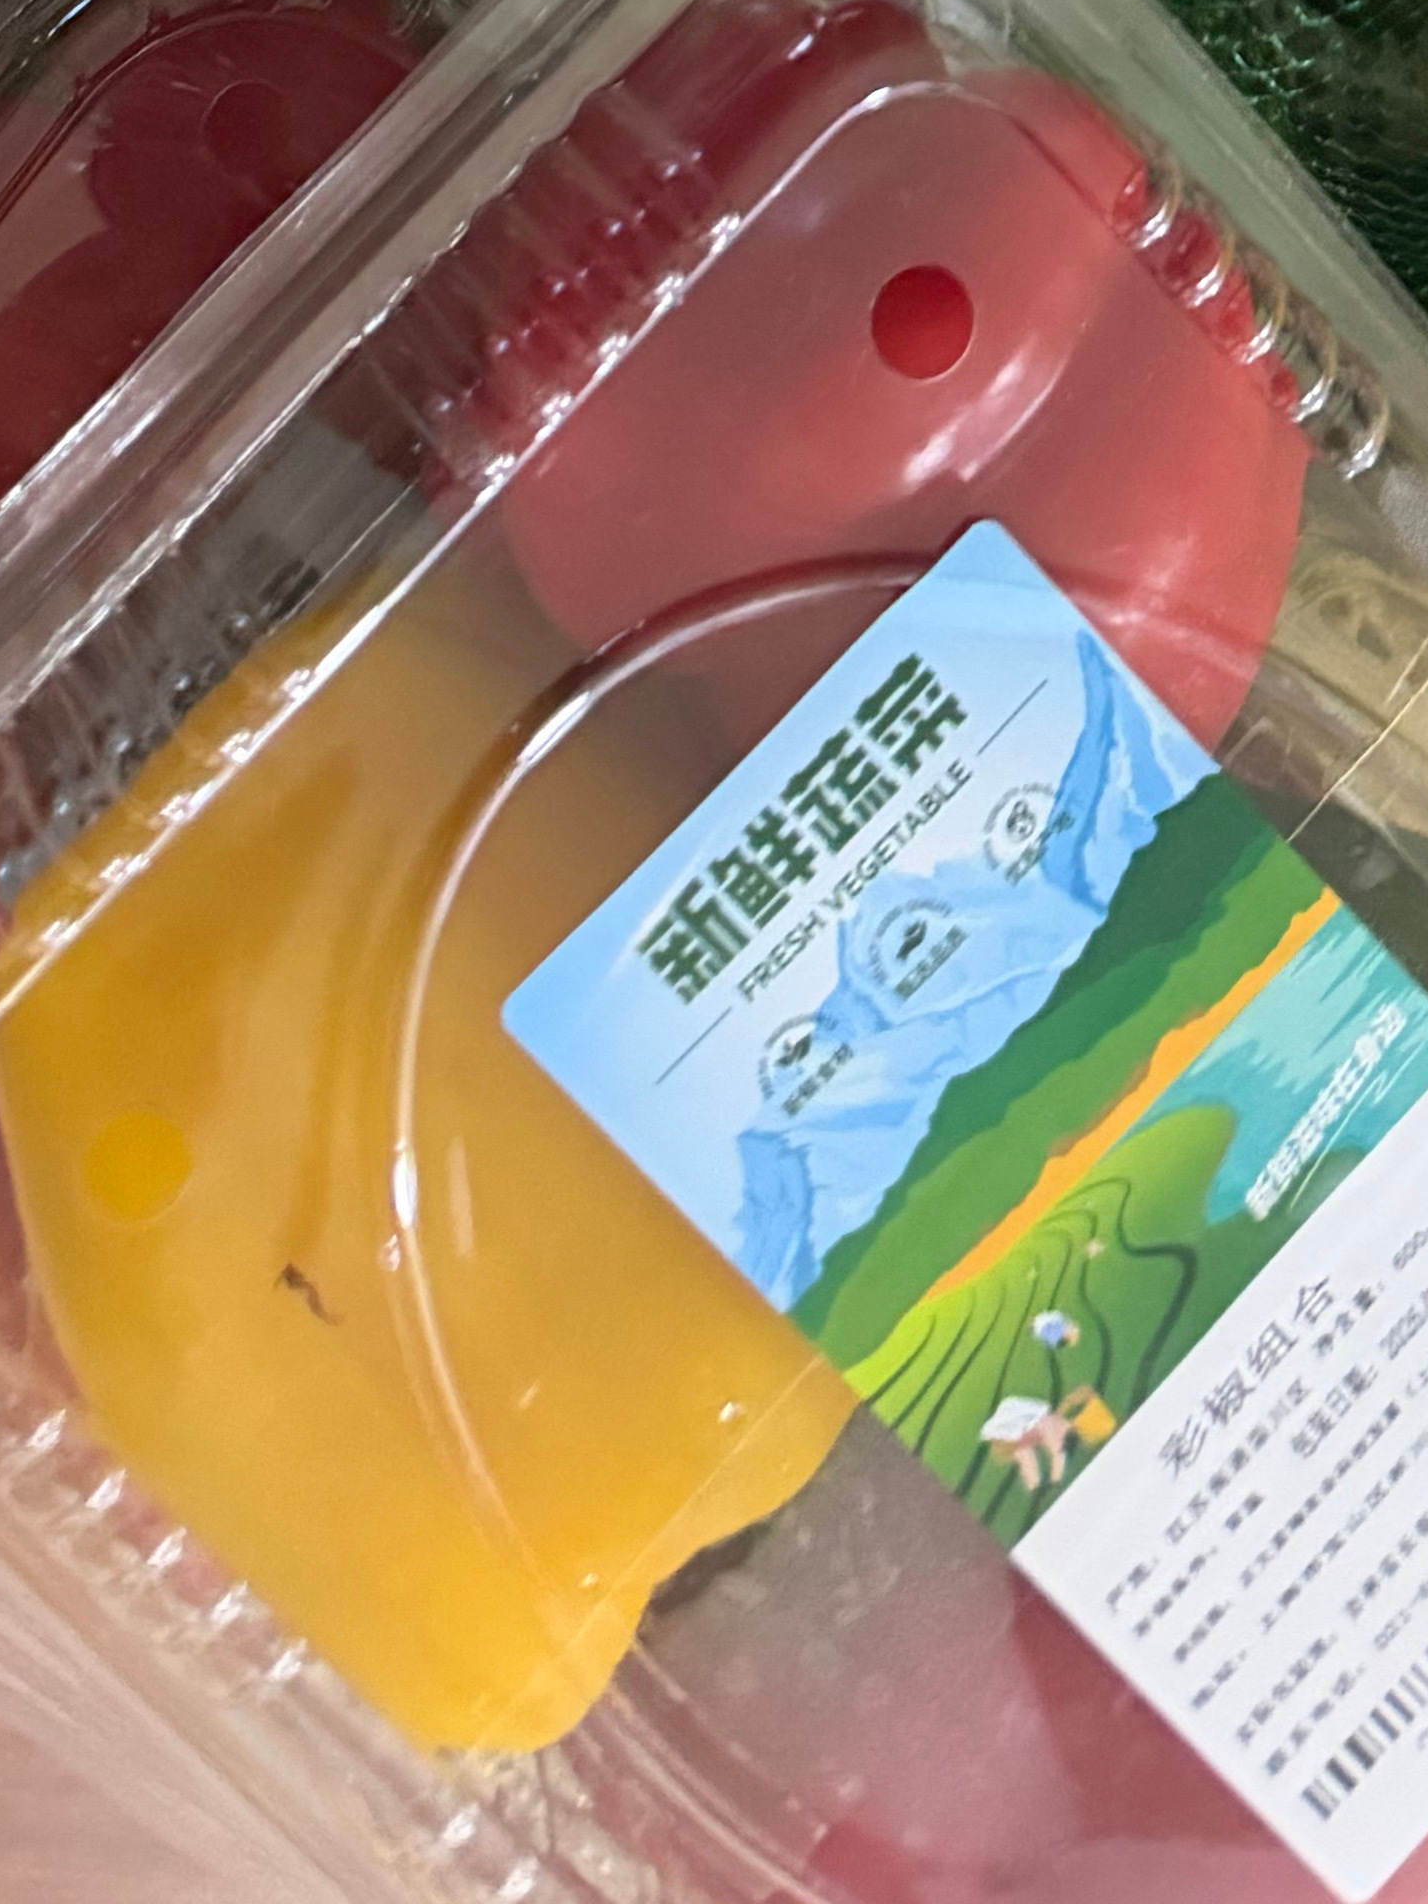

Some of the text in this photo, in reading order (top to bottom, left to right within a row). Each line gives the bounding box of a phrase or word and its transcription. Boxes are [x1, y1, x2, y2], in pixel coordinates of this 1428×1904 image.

[630, 649, 969, 1007] 新鲜蔬菜
[735, 911, 825, 1003] FRESH
[820, 757, 973, 917] VEGETABLE
[1160, 1266, 1344, 1481] 彩椒组合
